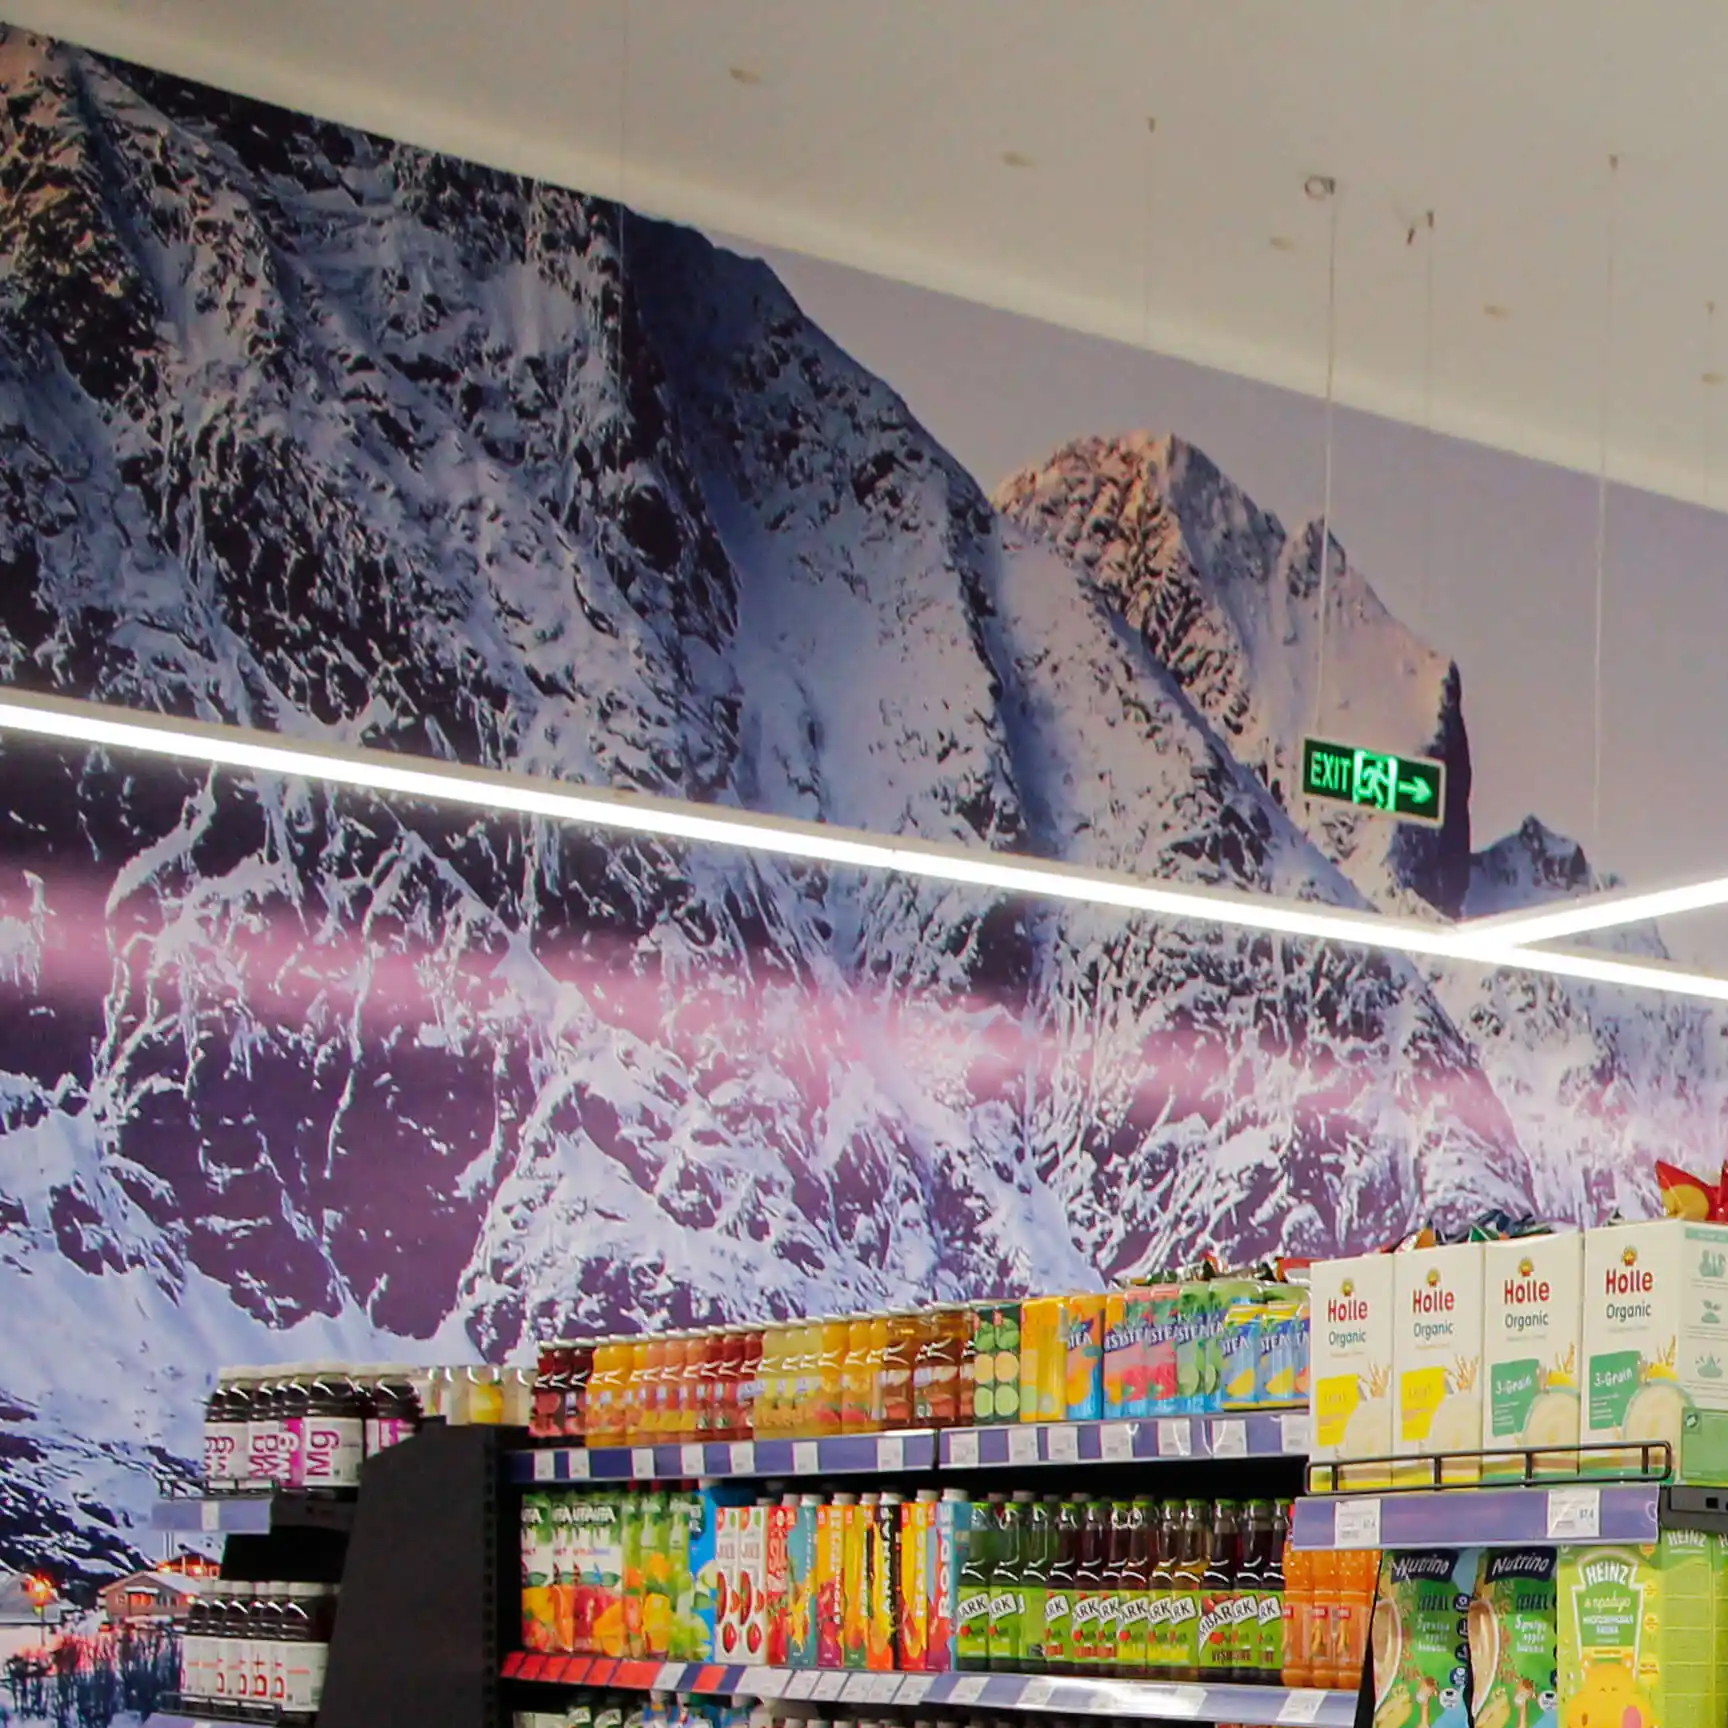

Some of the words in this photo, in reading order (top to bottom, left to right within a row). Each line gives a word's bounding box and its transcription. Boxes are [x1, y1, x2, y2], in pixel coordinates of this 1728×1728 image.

[1310, 751, 1351, 793] EXIT
[1504, 1278, 1551, 1305] Holle
[1605, 1268, 1653, 1296] Holle
[1327, 1298, 1368, 1324] Holle
[1412, 1287, 1455, 1315] Holle
[1606, 1302, 1652, 1321] Organic
[1413, 1320, 1454, 1340] Organic
[1505, 1310, 1549, 1331] Organic
[1328, 1329, 1367, 1348] Organic
[1495, 1375, 1532, 1395] 3-Grain
[1593, 1367, 1633, 1388] 3-Grain
[307, 1430, 339, 1476] Mg
[1492, 1553, 1550, 1575] Nutrino
[1586, 1562, 1629, 1585] HEINZ
